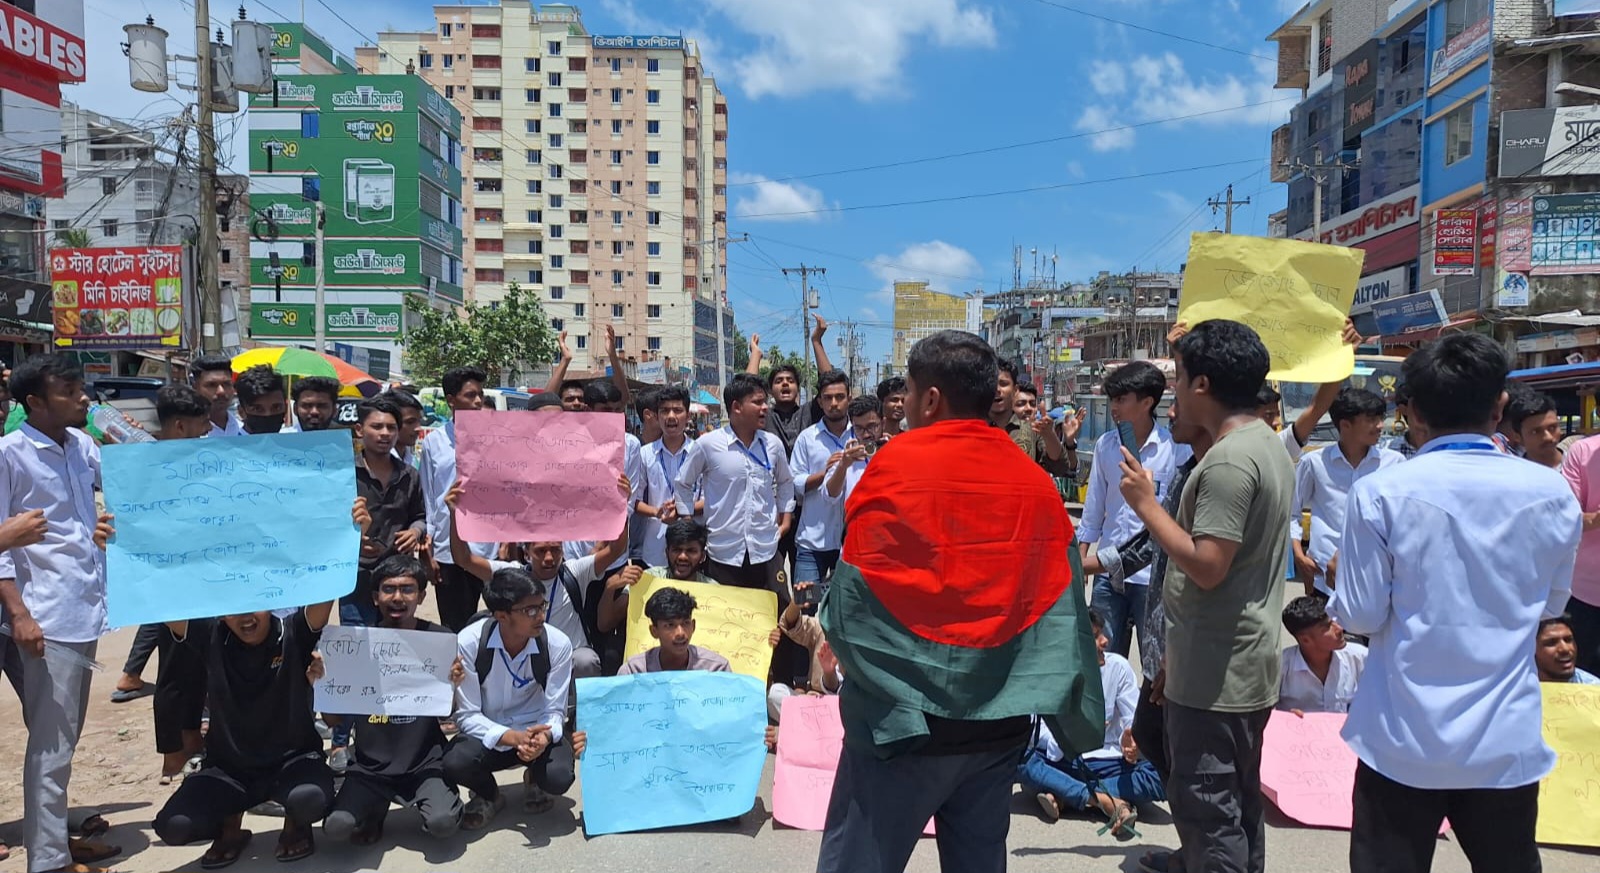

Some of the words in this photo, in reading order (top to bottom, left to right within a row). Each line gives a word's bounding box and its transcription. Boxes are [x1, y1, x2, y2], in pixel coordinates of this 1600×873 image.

[370, 90, 403, 105] সিমেন্ট
[68, 251, 94, 275] স্টার
[96, 249, 135, 276] হোটেল
[372, 253, 406, 269] সিমেন্ট
[82, 280, 107, 304] মিনি
[109, 279, 152, 305] চাইনিজ
[366, 311, 399, 328] সিমেন্ট
[322, 634, 365, 657] কোটা
